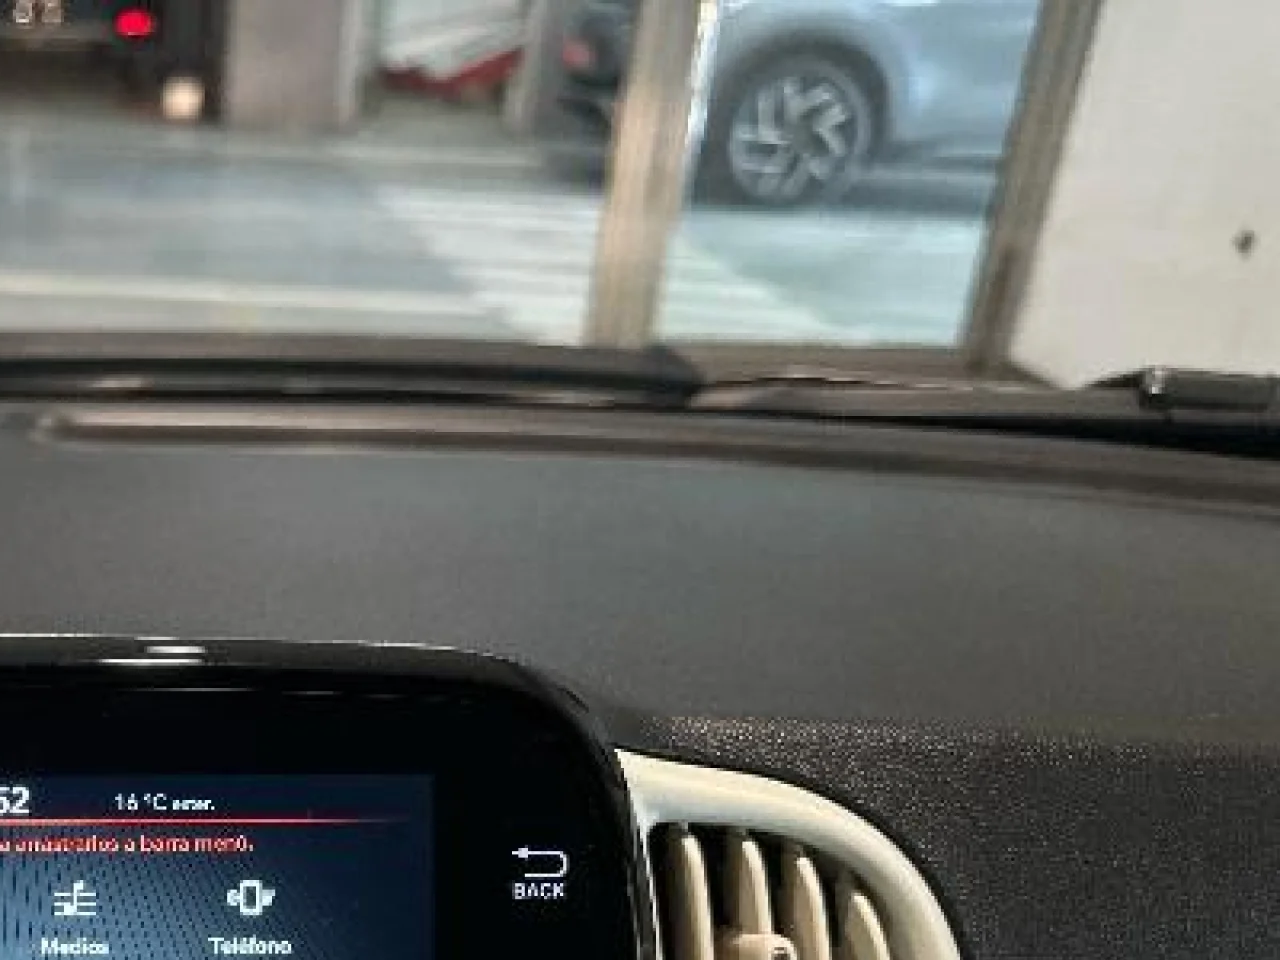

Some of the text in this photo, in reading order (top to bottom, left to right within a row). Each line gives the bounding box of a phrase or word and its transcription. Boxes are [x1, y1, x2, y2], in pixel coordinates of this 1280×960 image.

[114, 793, 138, 811] 16
[143, 793, 168, 811] °C
[124, 840, 136, 852] a
[140, 834, 191, 852] barra
[512, 881, 566, 900] BACK
[40, 936, 110, 956] Medios
[208, 934, 293, 956] Teléfono
